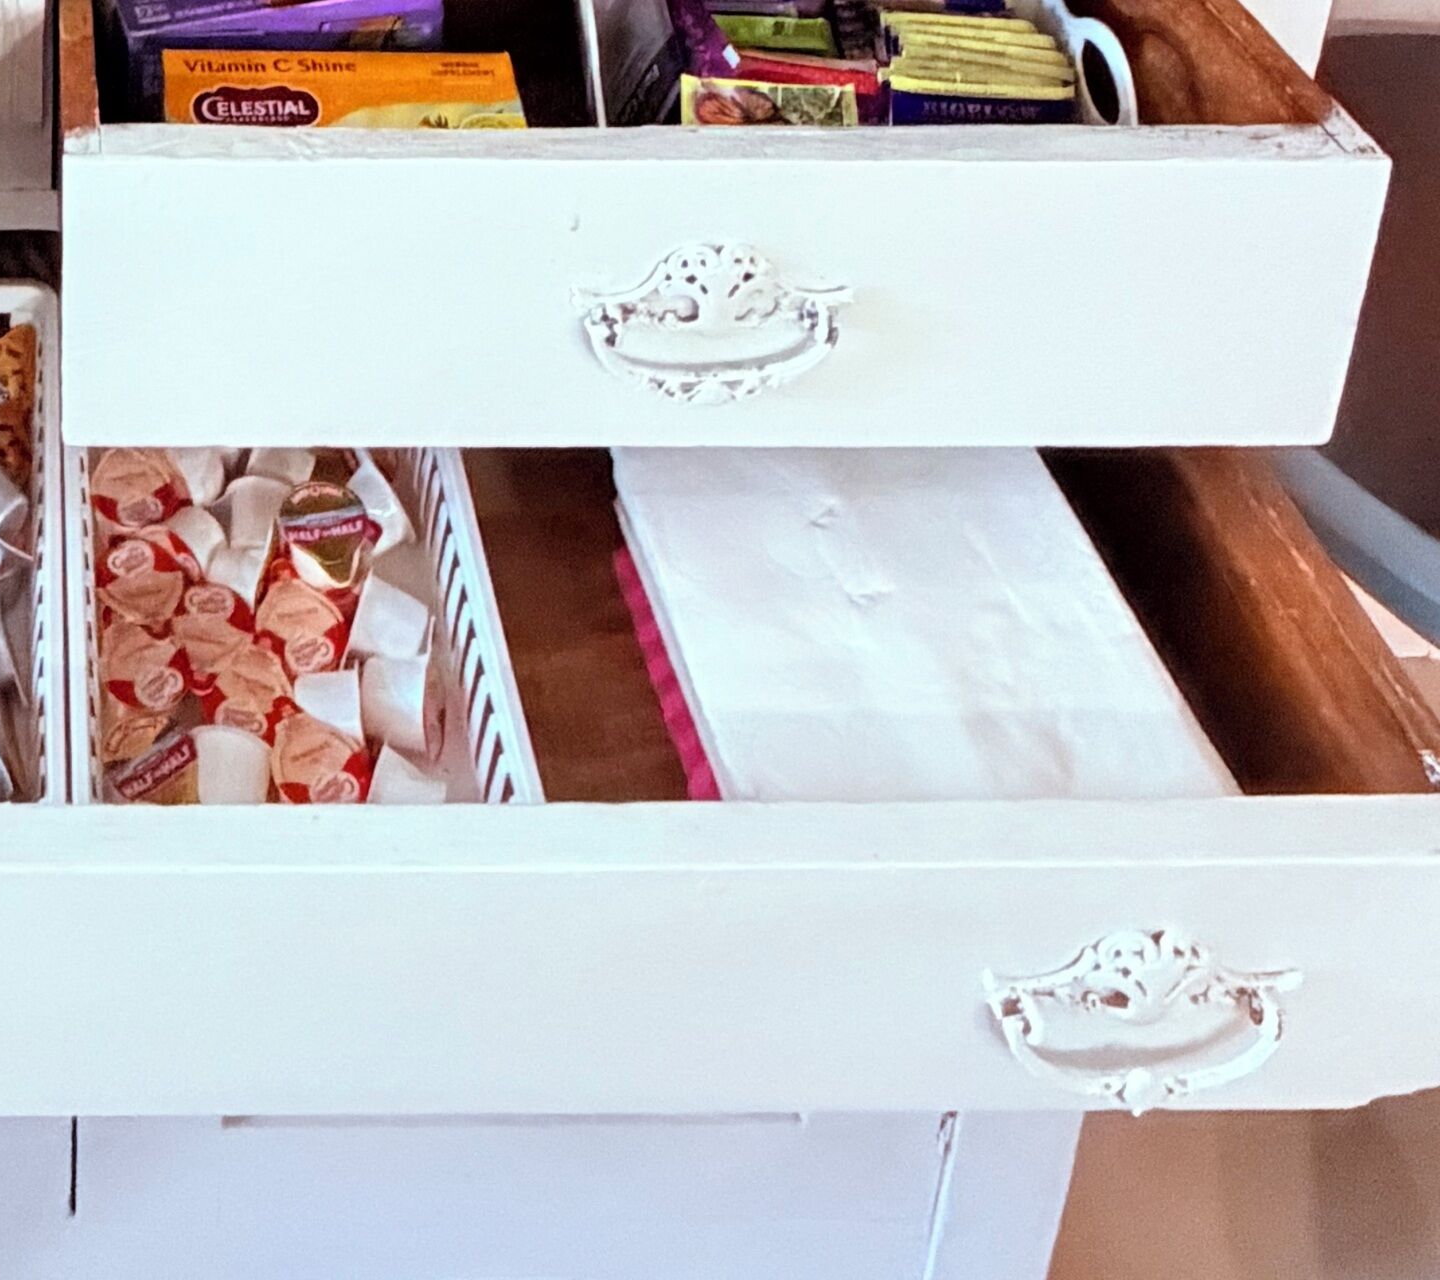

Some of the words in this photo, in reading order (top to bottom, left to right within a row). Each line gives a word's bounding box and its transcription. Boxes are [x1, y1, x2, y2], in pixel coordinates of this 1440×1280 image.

[183, 58, 266, 73] Vitamin
[273, 58, 291, 73] C
[297, 58, 357, 73] Shine
[201, 96, 310, 121] CELESTIAL
[330, 520, 363, 537] HALF
